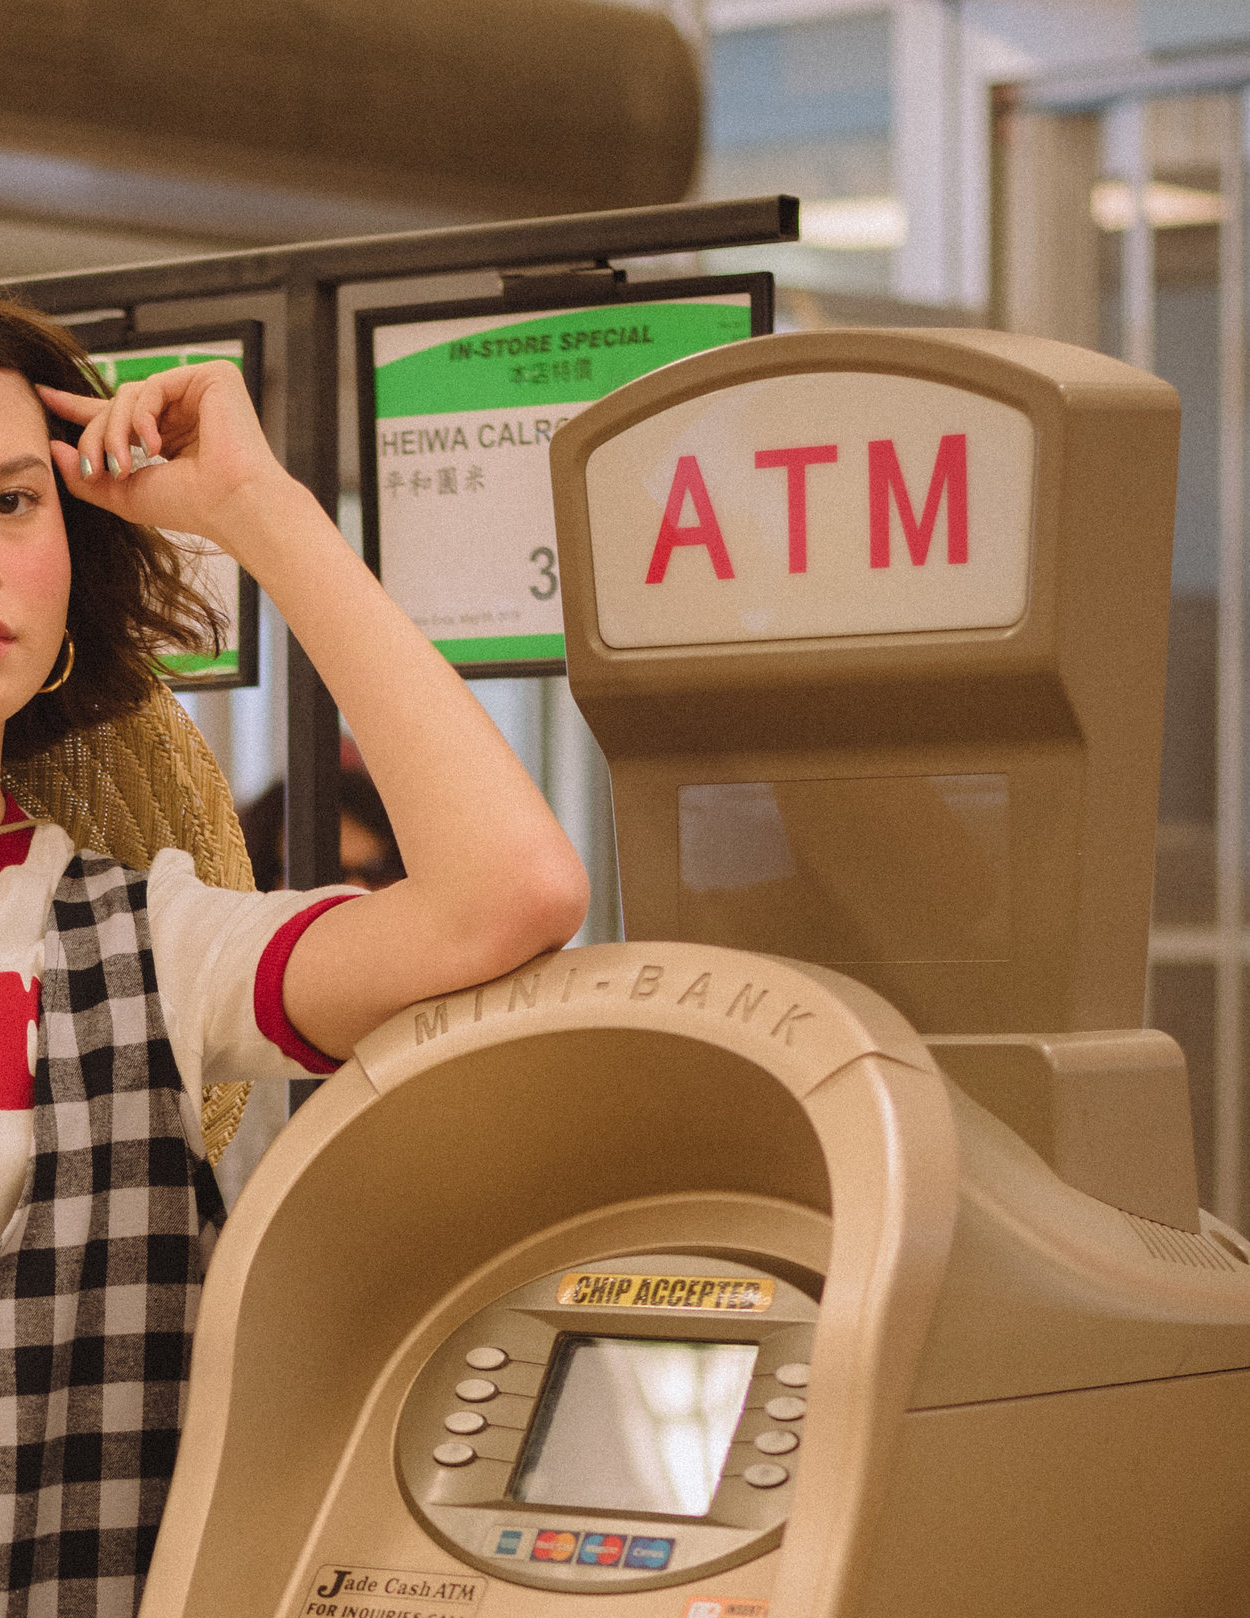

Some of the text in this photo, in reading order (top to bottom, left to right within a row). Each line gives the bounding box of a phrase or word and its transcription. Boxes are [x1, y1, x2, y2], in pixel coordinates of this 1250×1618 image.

[449, 326, 655, 360] IN-STORE SPECIAL
[381, 426, 469, 456] HEIWA
[644, 433, 970, 585] ATM
[412, 964, 818, 1048] MINI-BANK
[571, 1275, 762, 1311] CHIP ACCEPTED
[317, 1570, 476, 1602] Jade Cash ATM
[306, 1602, 338, 1617] FOR
